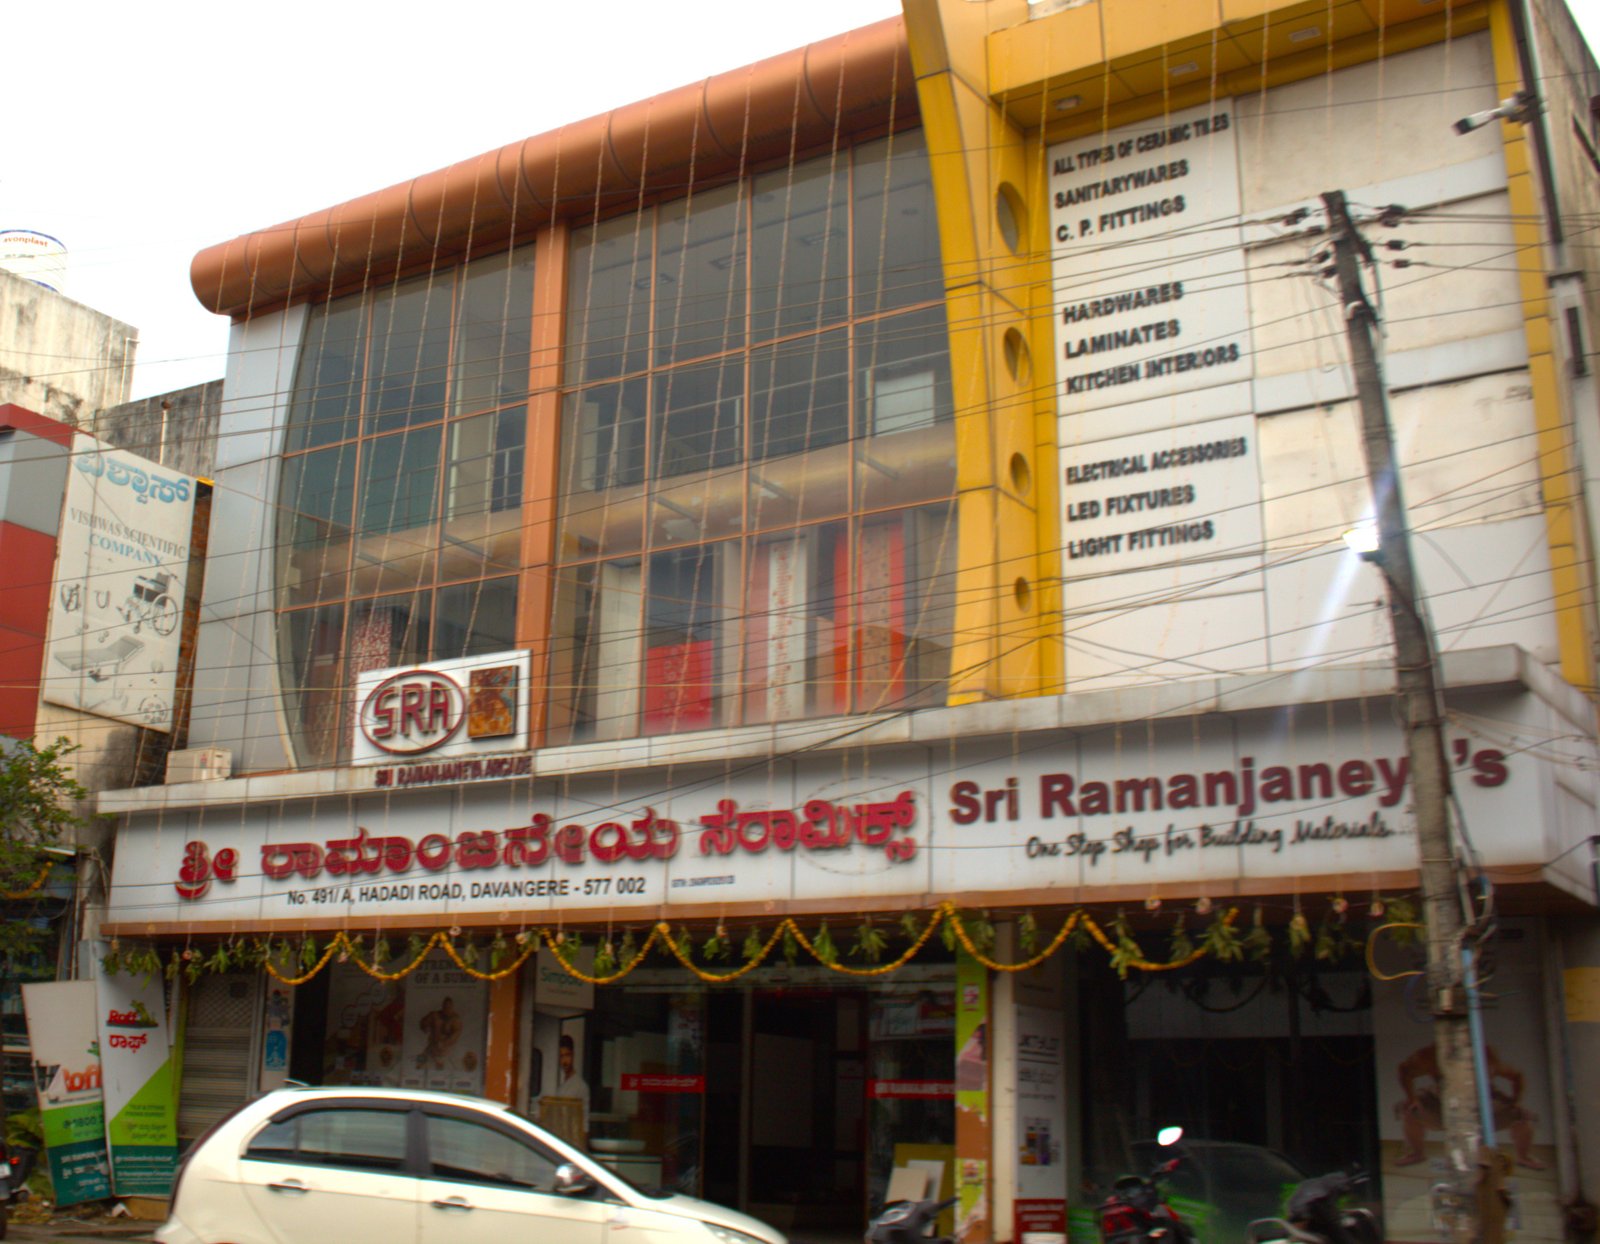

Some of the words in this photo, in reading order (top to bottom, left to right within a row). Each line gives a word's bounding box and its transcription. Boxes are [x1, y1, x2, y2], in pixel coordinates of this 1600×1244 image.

[1053, 158, 1076, 176] ALL
[1078, 146, 1116, 168] TYPES
[1117, 140, 1134, 158] OF
[1055, 159, 1190, 209] SANITARYWARES
[1057, 225, 1075, 242] C.
[1079, 219, 1095, 237] P.
[1099, 195, 1188, 233] FITTINGS
[1064, 281, 1185, 325] HARDWARES
[1065, 319, 1181, 359] LAMINATES
[1066, 363, 1141, 394] KITCHEN
[1146, 343, 1240, 380] INTERIORS
[1066, 454, 1147, 486] ELECTRICAL
[1151, 436, 1248, 469] ACCESSORIES
[1067, 501, 1101, 522] LED
[1106, 484, 1196, 516] FIXTURES
[70, 508, 123, 538] VISHWAS
[123, 526, 186, 559] SCIENTIFIC
[89, 533, 164, 566] COMPANY
[1068, 533, 1124, 560] LIGHT
[1128, 520, 1215, 552] FITTINGS
[373, 681, 454, 738] SRA
[949, 777, 1020, 825] Sri
[1040, 738, 1509, 817] Ramanjaney's
[174, 840, 238, 901] ಶ್ರೀ
[261, 806, 681, 881] ರಾಮಾಂಜನೇಯ
[1026, 836, 1061, 859] One
[1065, 832, 1107, 866] Stop
[1111, 826, 1161, 864] Shop
[1165, 823, 1195, 856] for
[1200, 821, 1283, 853] Building
[287, 890, 308, 905] No.
[359, 885, 415, 902] HADADI
[418, 882, 466, 901] ROAD,
[470, 879, 569, 900] DAVANGERE
[584, 879, 611, 896] 577
[616, 877, 645, 895] 002
